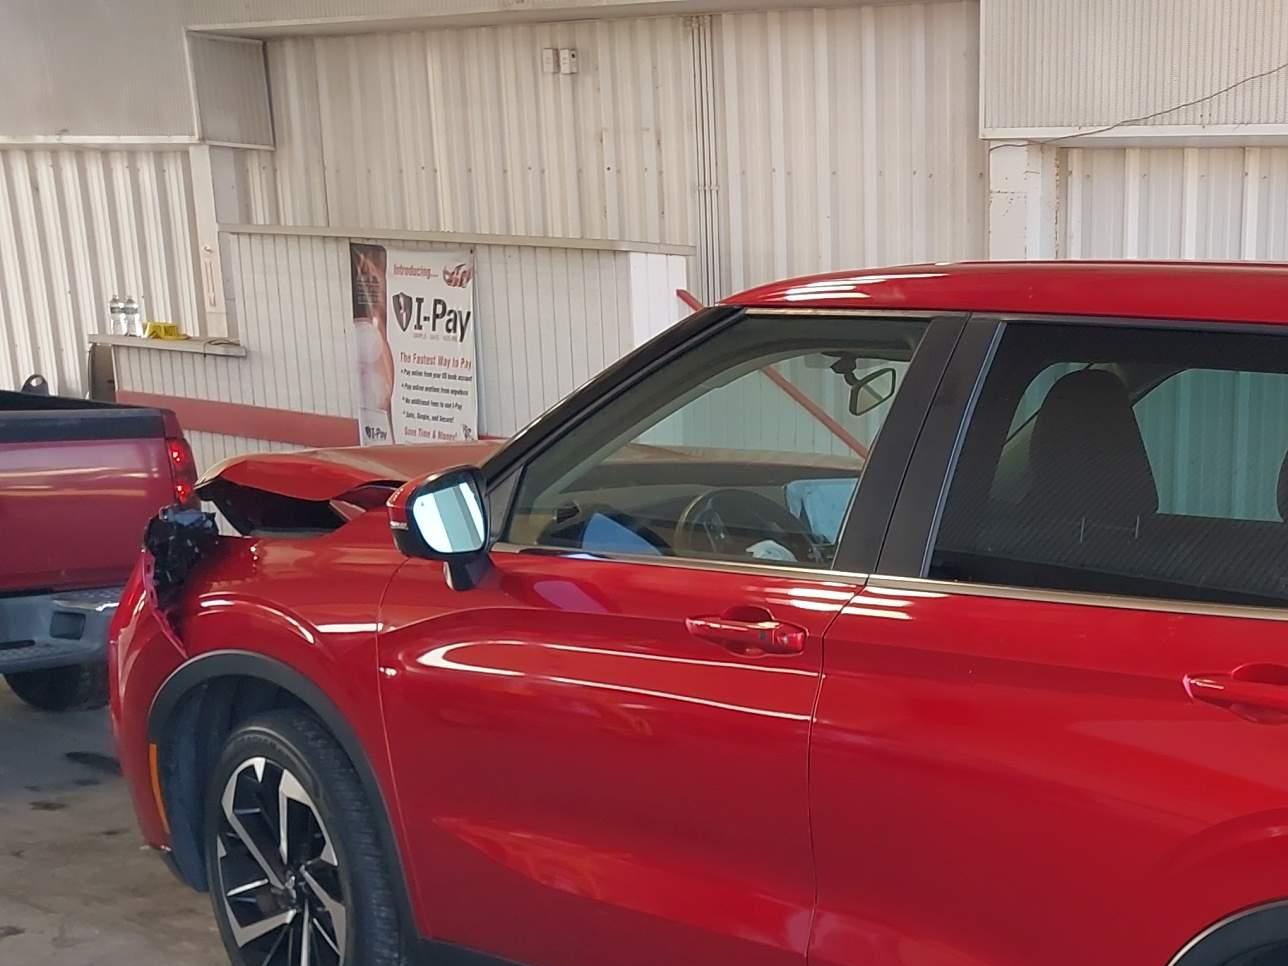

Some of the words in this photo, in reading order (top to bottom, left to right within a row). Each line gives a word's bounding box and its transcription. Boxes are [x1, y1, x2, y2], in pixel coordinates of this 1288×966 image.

[414, 297, 471, 342] I-Pay
[400, 352, 411, 363] The
[413, 353, 436, 365] Fastest
[438, 355, 450, 369] Way
